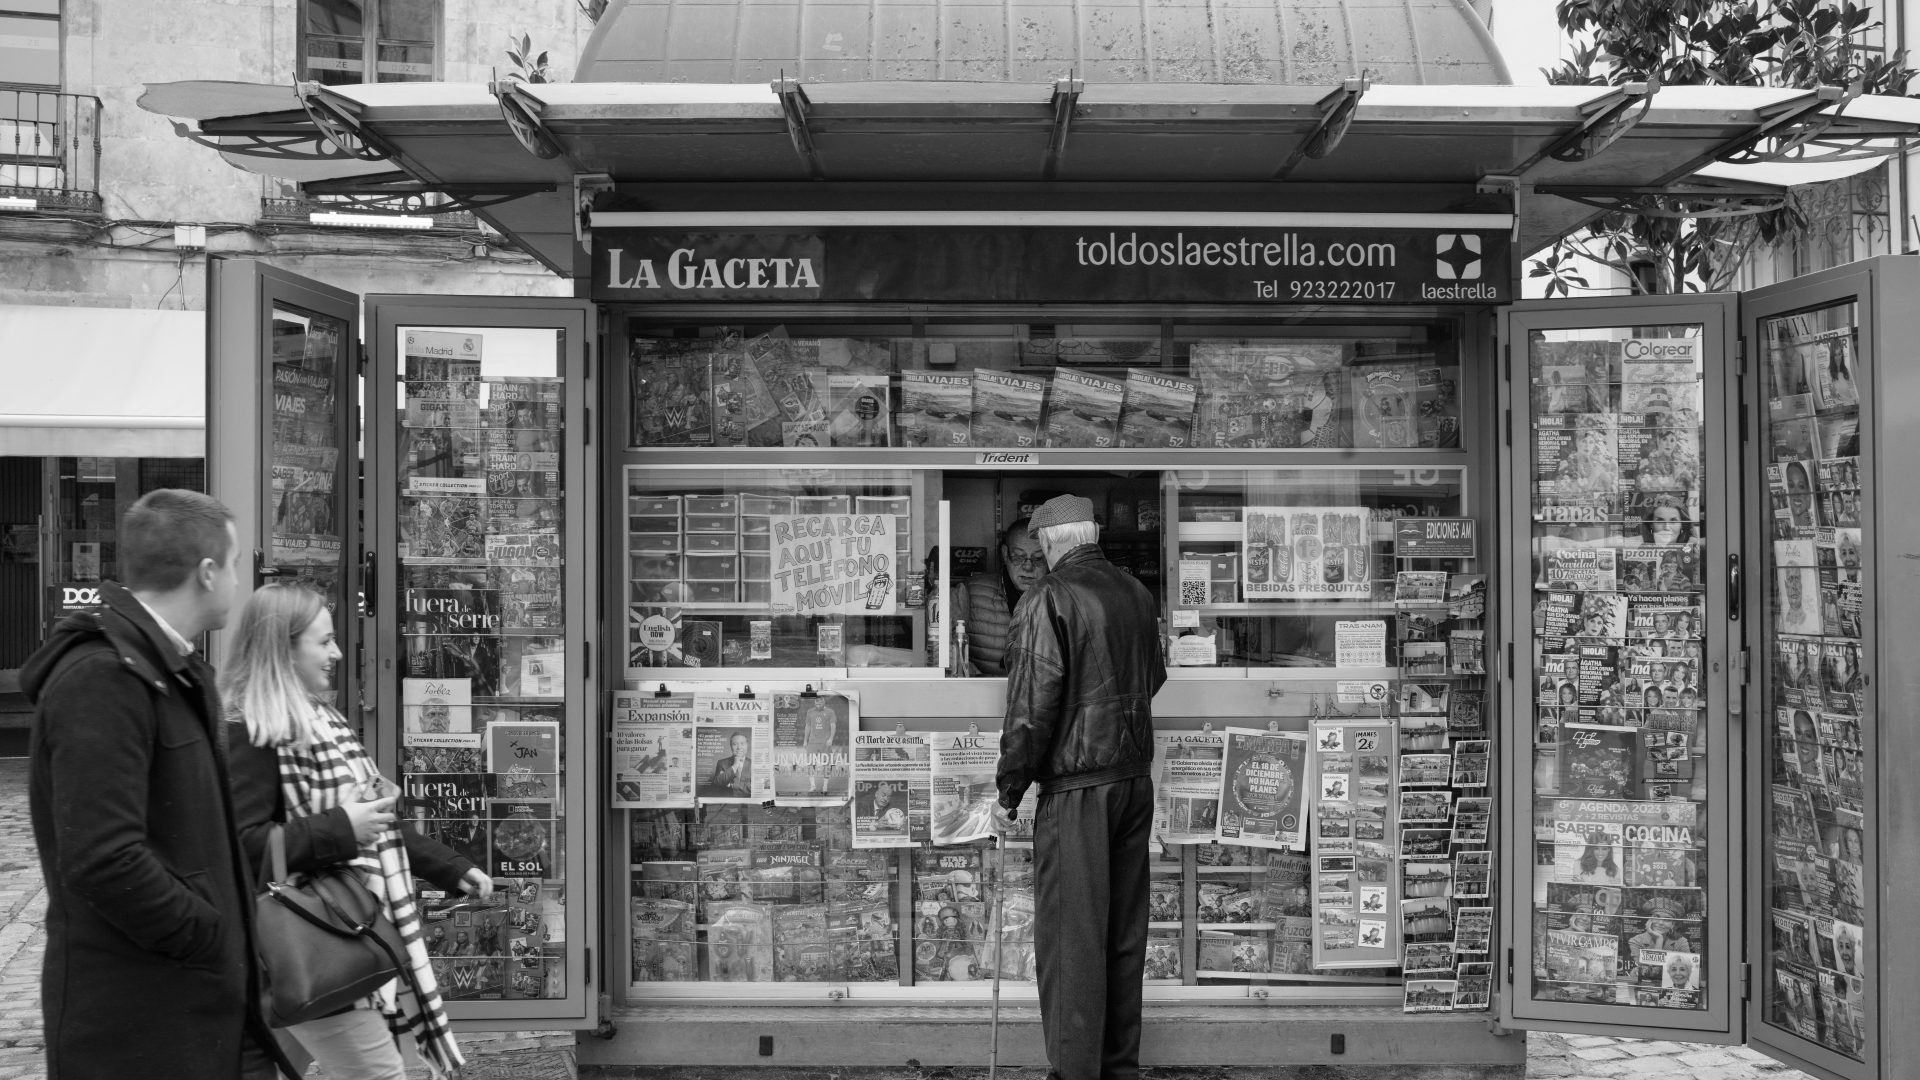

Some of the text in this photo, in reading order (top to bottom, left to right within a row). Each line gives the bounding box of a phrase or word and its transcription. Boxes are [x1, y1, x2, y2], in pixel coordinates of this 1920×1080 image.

[1076, 232, 1395, 267] toldoslaestrella.com
[1253, 280, 1396, 300] Tel 923222017
[1421, 281, 1497, 300] laestrella
[426, 346, 453, 356] Madrid
[1624, 341, 1693, 359] Colorear
[927, 376, 970, 387] VIAJES
[1000, 376, 1042, 392] VIAJES
[1081, 376, 1123, 393] VIAJES
[1154, 377, 1196, 393] VIAJES
[491, 384, 518, 392] TRAIN
[492, 392, 518, 401] HARD
[275, 393, 306, 414] VIAJES
[420, 402, 466, 412] GIGANTES
[1539, 417, 1563, 427] ¡HOLA!
[1620, 415, 1644, 425] ¡HOLA!
[952, 432, 967, 445] 52
[1018, 436, 1033, 448] 52
[1095, 436, 1110, 448] 52
[1169, 436, 1185, 448] 52
[490, 454, 517, 463] TRAIN
[982, 452, 1030, 465] Trident
[491, 462, 517, 470] HARD
[489, 472, 511, 484] Sport
[494, 480, 515, 493] Life
[1542, 505, 1609, 521] Tapas
[775, 515, 886, 545] RECARGA
[1426, 521, 1472, 539] EDICIONES AM
[285, 539, 307, 548] VIAJES
[321, 540, 342, 550] VIAJES
[841, 536, 872, 557] TU
[1555, 549, 1596, 559] Cocina
[1624, 549, 1665, 560] pronto
[1554, 558, 1598, 570] Navidad
[774, 553, 890, 593] TELÉFONO
[1550, 569, 1569, 580] 107
[1246, 583, 1370, 593] BEBIDAS FRESQUITAS
[405, 588, 460, 613] fuera
[795, 579, 869, 612] MÓVIL
[1549, 593, 1573, 603] ¡HOLA!
[1627, 595, 1689, 604] Ya hacen planes
[461, 604, 472, 613] de
[447, 612, 500, 629] serie
[1634, 612, 1654, 627] má
[643, 624, 671, 633] English
[650, 631, 665, 639] now
[1582, 646, 1606, 656] ¡HOLA!
[1545, 658, 1565, 673] má
[1630, 662, 1651, 676] má
[628, 708, 691, 724] Expansión
[855, 735, 925, 745] El Norte de Castilla
[1185, 736, 1223, 744] GACETA
[1355, 730, 1378, 739] IMANES
[952, 736, 986, 749] ABC
[1357, 737, 1375, 750] 2€
[514, 745, 538, 759] JAN
[616, 745, 630, 753] para
[792, 752, 851, 767] MUNDIAL
[1270, 763, 1280, 771] DE
[1245, 769, 1285, 780] DICIEMBRE
[403, 775, 457, 798] fuera
[1248, 777, 1279, 787] NO HAGA
[459, 788, 470, 796] de
[1249, 785, 1278, 794] PLANES
[447, 796, 488, 812] seri
[1578, 802, 1662, 814] AGENDA 2023
[1597, 813, 1639, 821] REVISTAS
[1556, 823, 1605, 833] SABER
[1625, 825, 1692, 845] COCINA
[769, 854, 811, 866] NINJAGO
[501, 862, 543, 872] EL SOL
